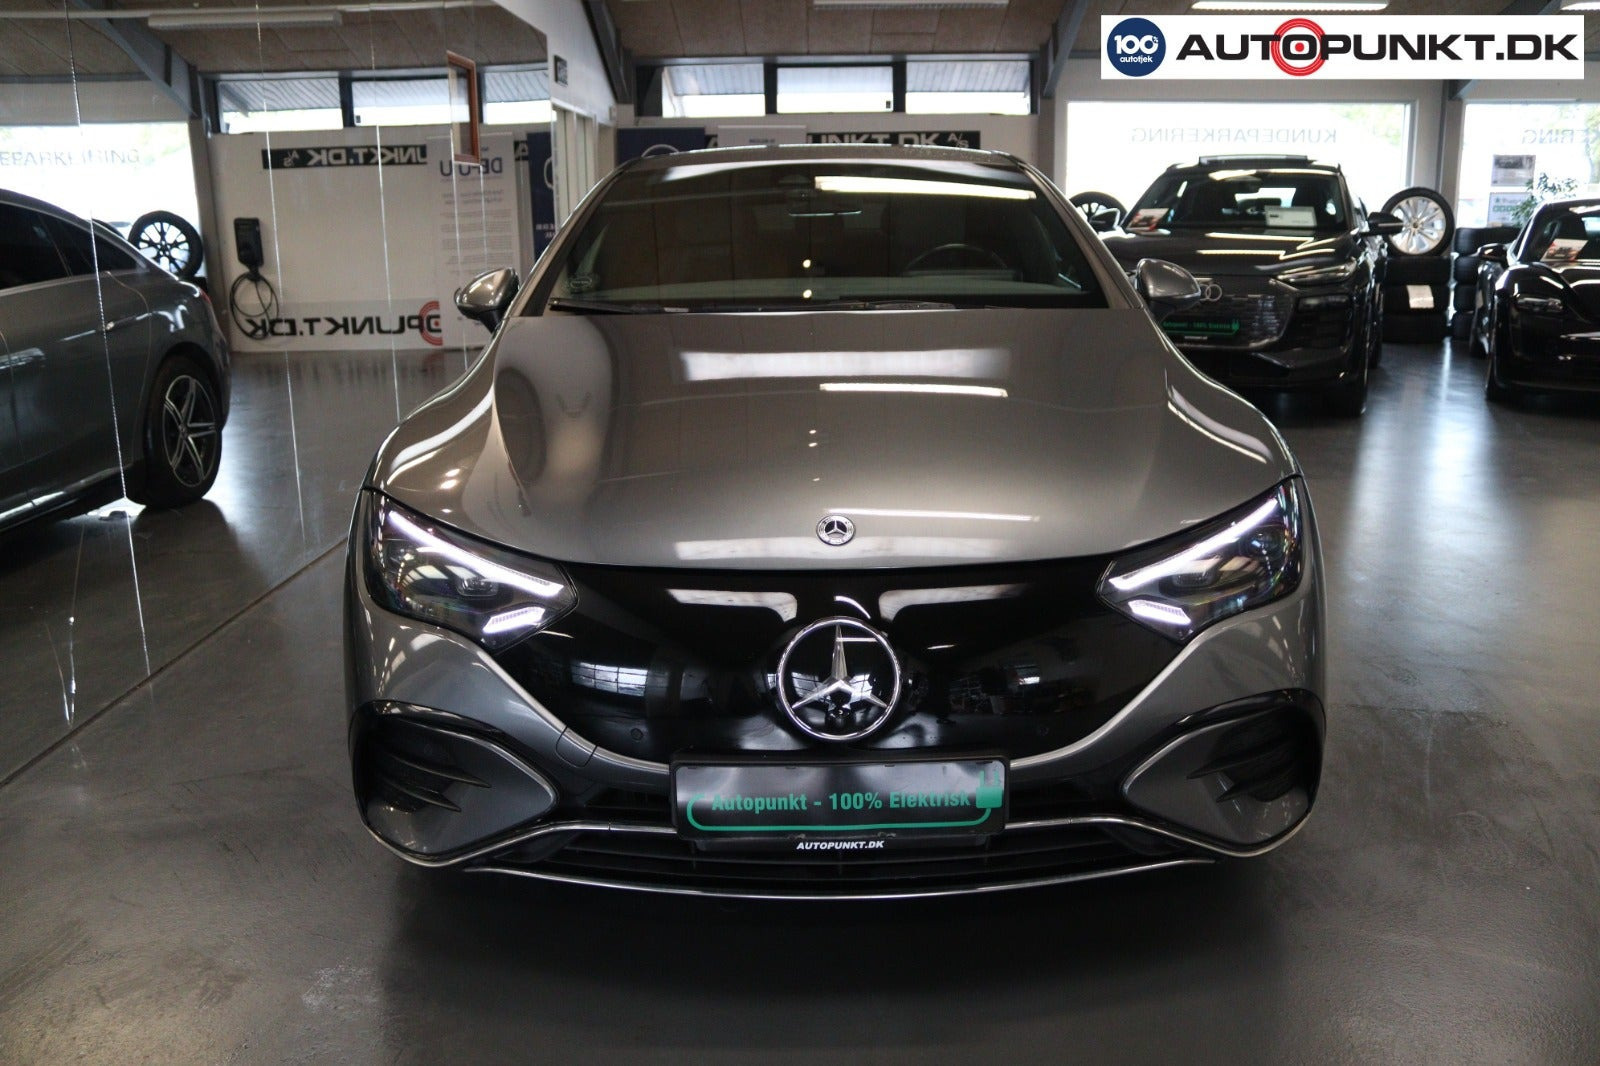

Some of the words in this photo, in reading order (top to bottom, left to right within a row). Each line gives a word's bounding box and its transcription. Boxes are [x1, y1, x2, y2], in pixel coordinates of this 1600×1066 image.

[711, 793, 808, 813] Autopunkt
[829, 792, 883, 811] 100%
[889, 790, 971, 809] Elektrisk
[796, 839, 885, 851] AUTOPUNKT.DK
